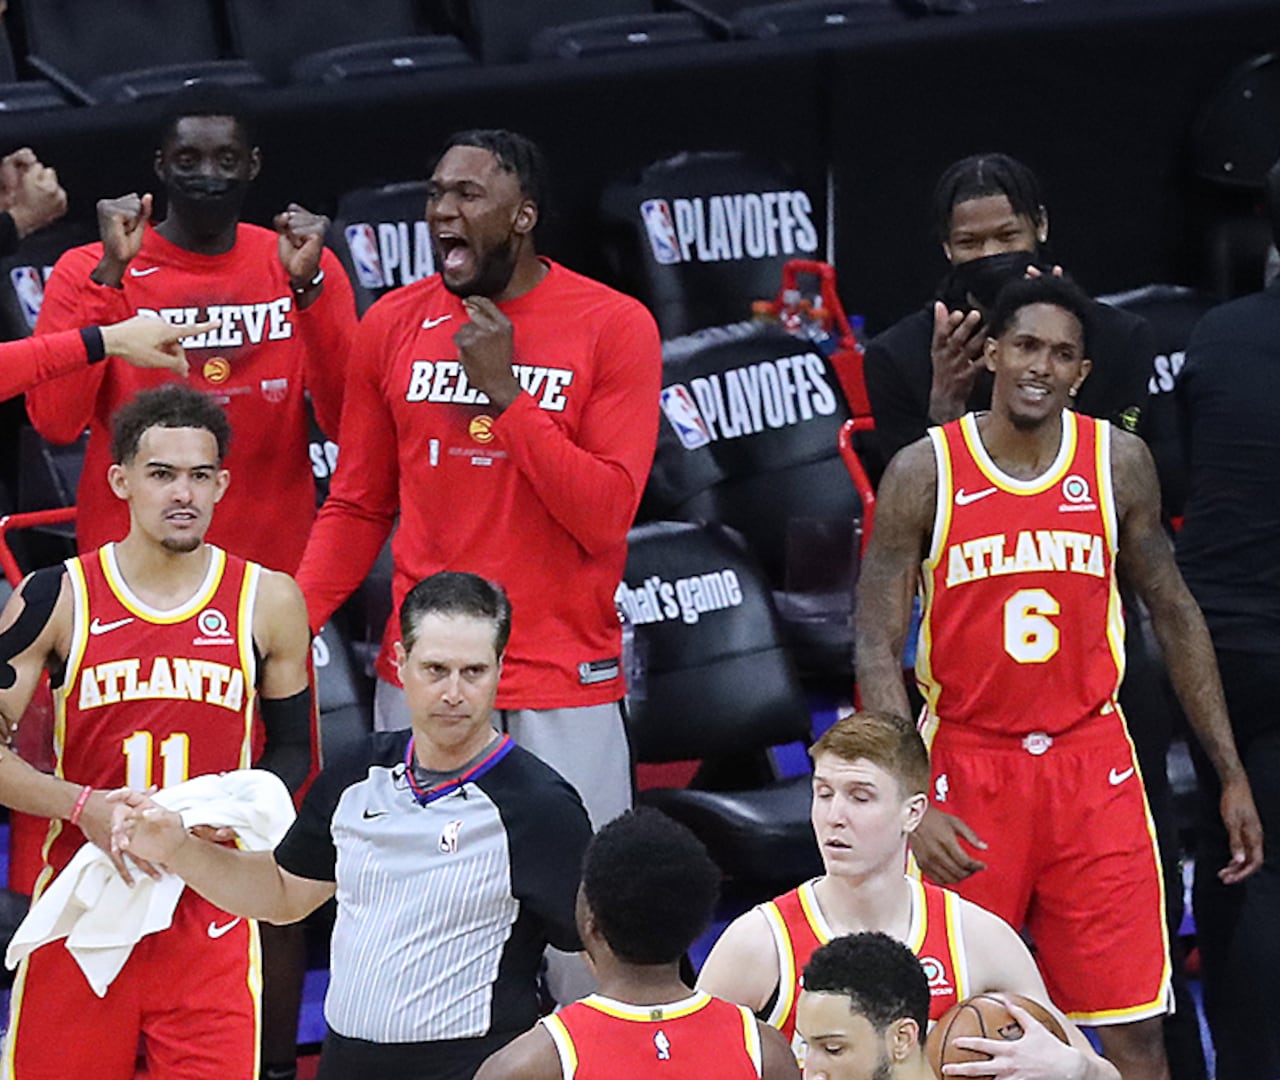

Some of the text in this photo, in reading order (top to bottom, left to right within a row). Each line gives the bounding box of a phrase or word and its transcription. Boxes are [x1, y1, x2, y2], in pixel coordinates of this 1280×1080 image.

[673, 190, 818, 262] PLAYOFFS
[137, 296, 293, 349] ELIEVE
[405, 360, 574, 411] BELVE
[690, 352, 837, 441] PLAYOFFS
[945, 530, 1105, 589] ATLANTA
[674, 569, 743, 624] game
[1004, 588, 1061, 663] 6
[79, 656, 244, 712] ATLANTA
[123, 730, 190, 794] 11
